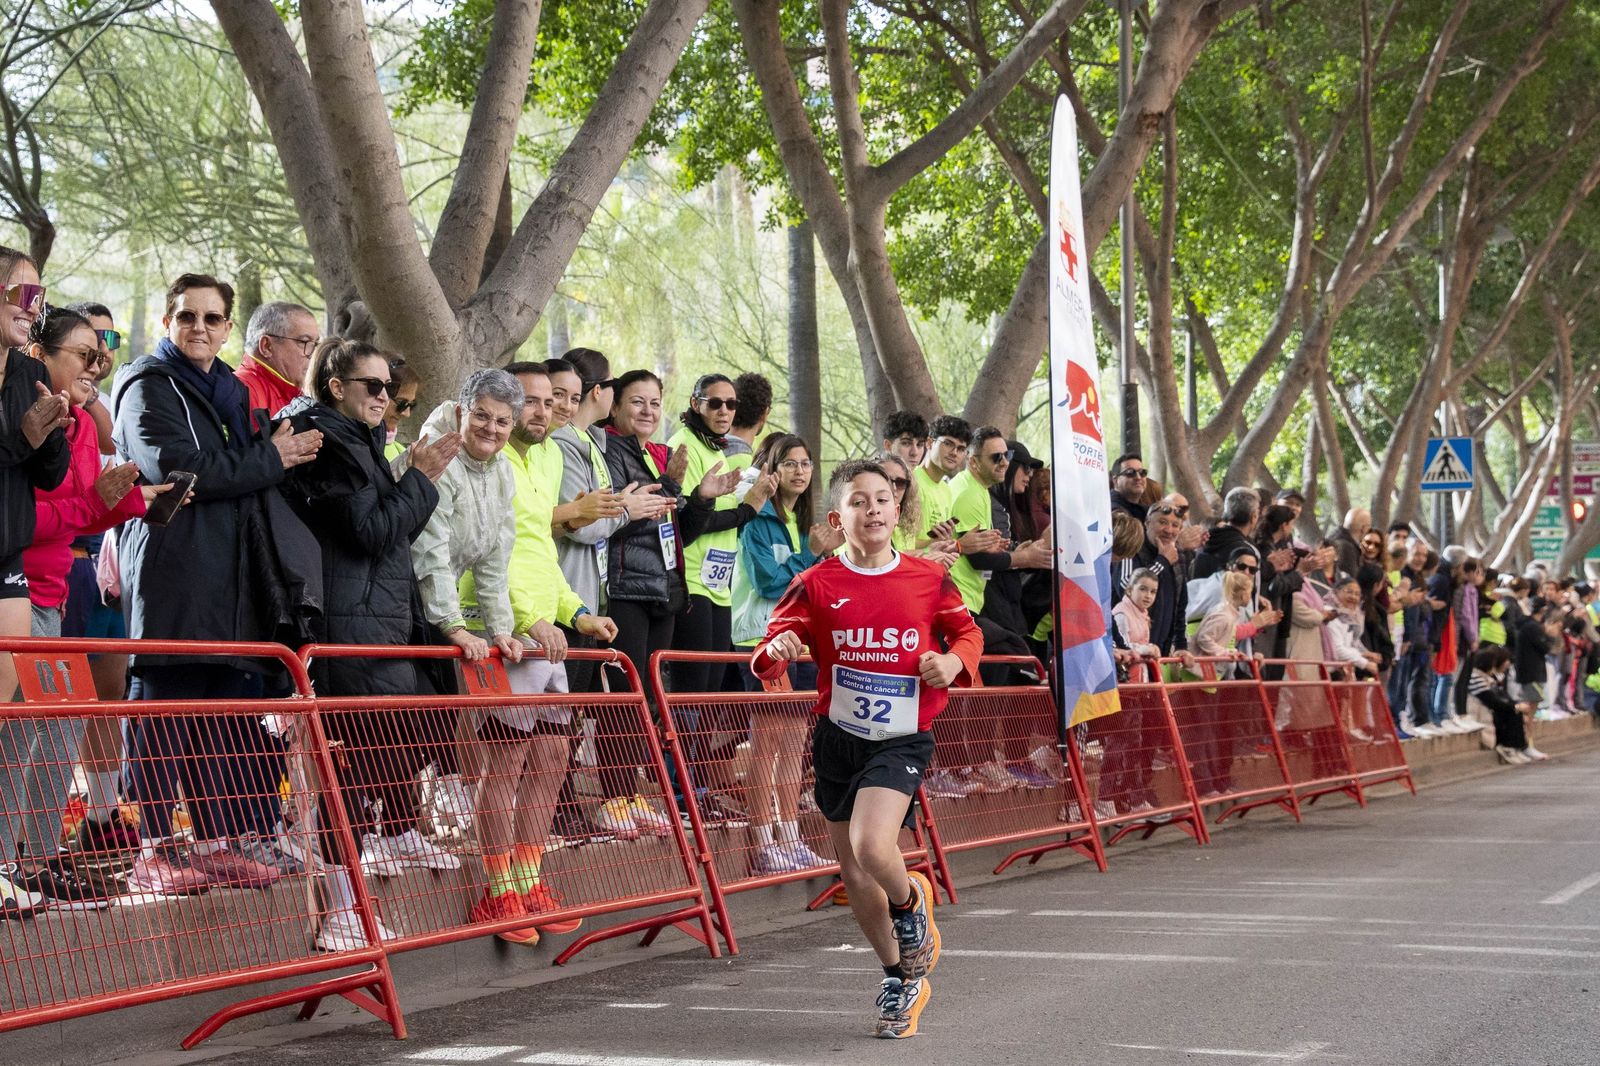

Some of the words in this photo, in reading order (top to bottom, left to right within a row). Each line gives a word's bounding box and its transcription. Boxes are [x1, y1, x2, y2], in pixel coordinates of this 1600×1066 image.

[840, 651, 899, 662] RUNNING
[842, 679, 864, 690] contra
[874, 686, 899, 694] cáncer
[845, 671, 872, 683] Almería
[883, 679, 909, 687] marcha
[853, 696, 892, 724] 32
